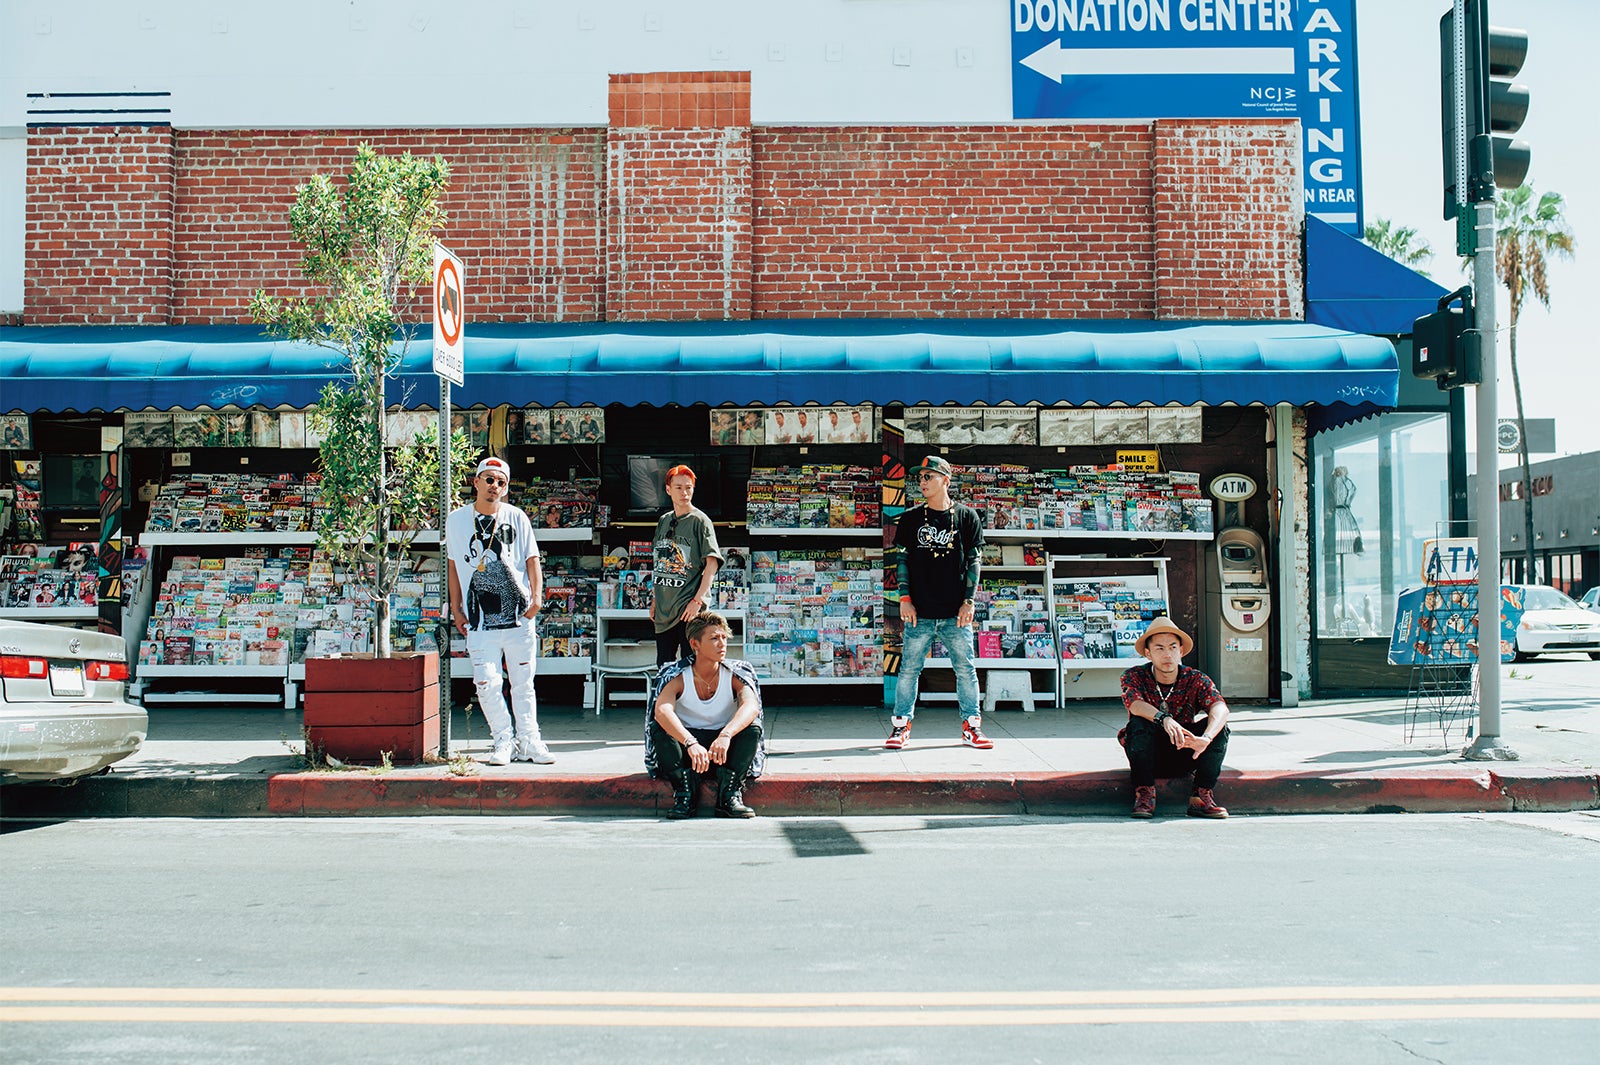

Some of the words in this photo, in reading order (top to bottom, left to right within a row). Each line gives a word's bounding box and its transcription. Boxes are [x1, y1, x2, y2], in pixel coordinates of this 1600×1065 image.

[1015, 0, 1175, 32] DONATION
[1179, 0, 1295, 31] CENTER
[1303, 0, 1344, 183] ARKING
[1304, 189, 1315, 203] N
[1319, 188, 1356, 203] REAR
[1118, 455, 1147, 463] SMILE
[1221, 481, 1247, 494] ATM
[242, 493, 263, 502] car
[850, 593, 872, 601] Color
